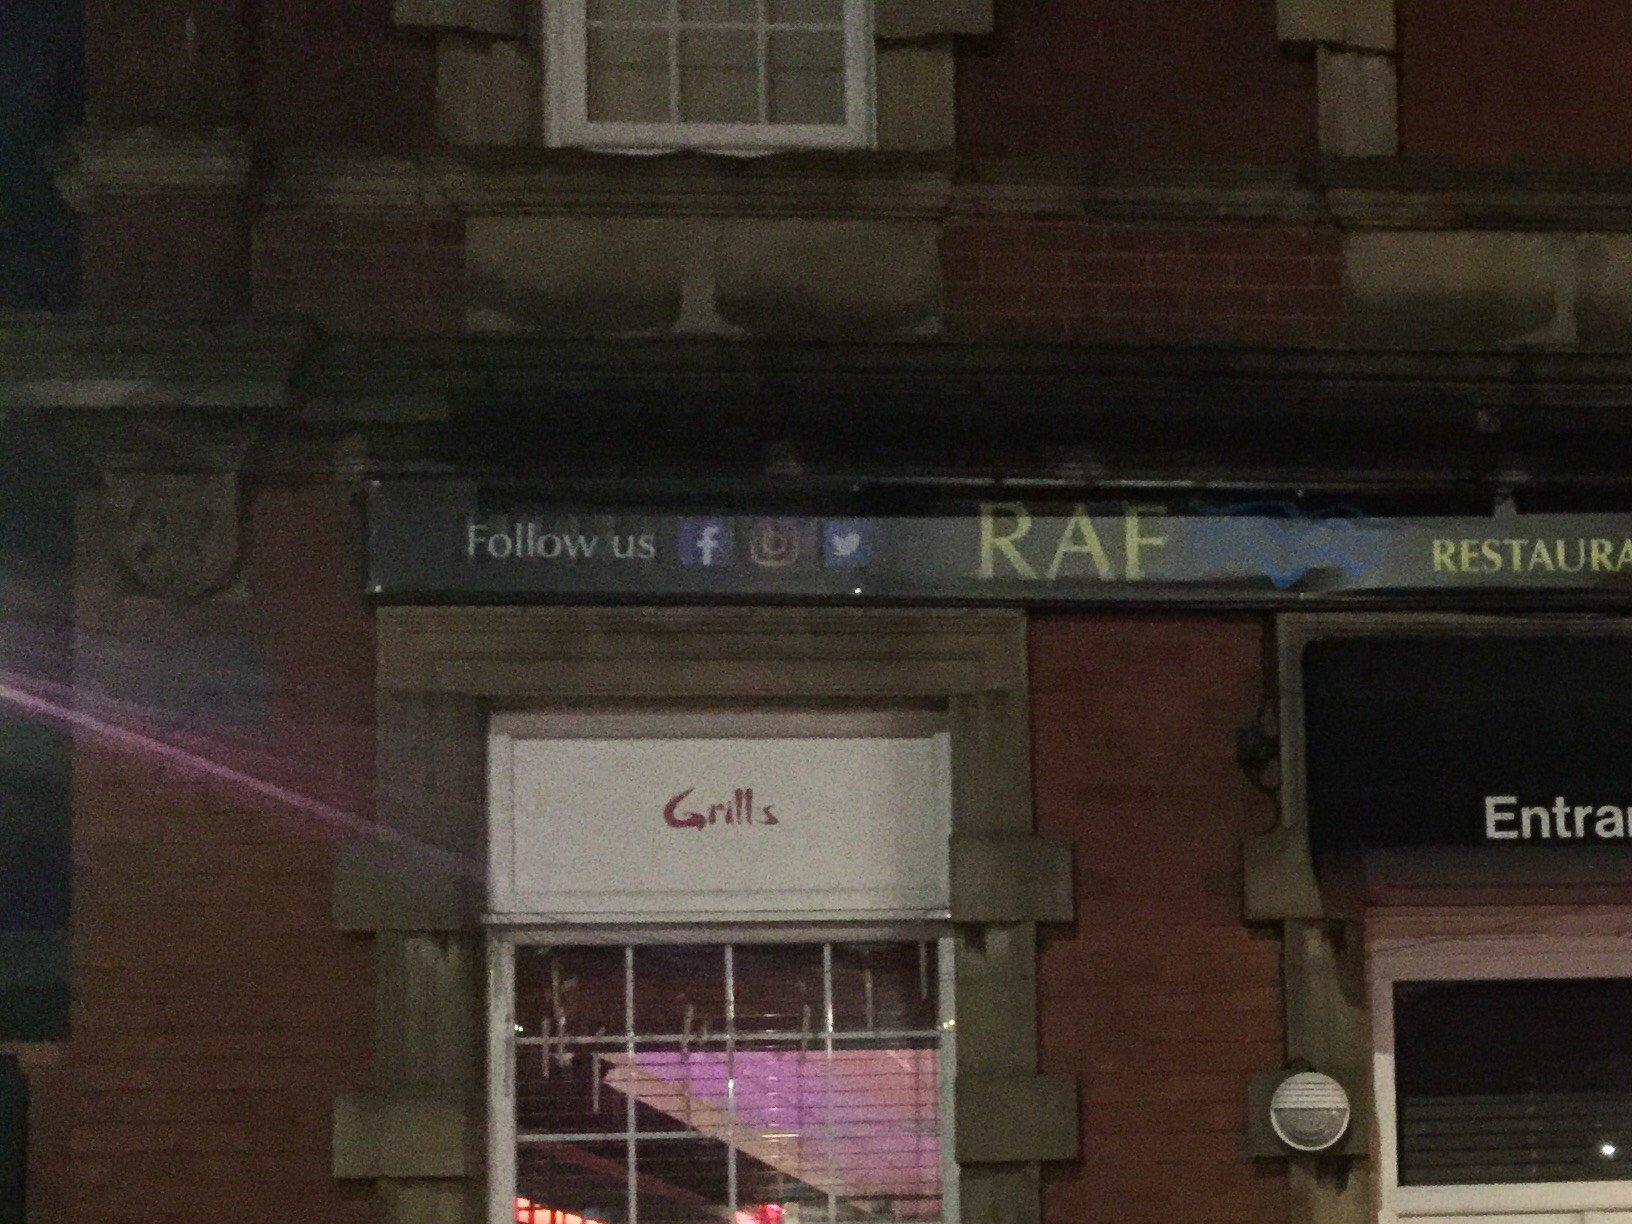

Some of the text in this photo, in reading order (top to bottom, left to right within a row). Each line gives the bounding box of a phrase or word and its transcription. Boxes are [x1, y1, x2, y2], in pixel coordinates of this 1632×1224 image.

[466, 519, 656, 559] Follow us
[977, 501, 1168, 581] RAF
[663, 784, 779, 831] Grills
